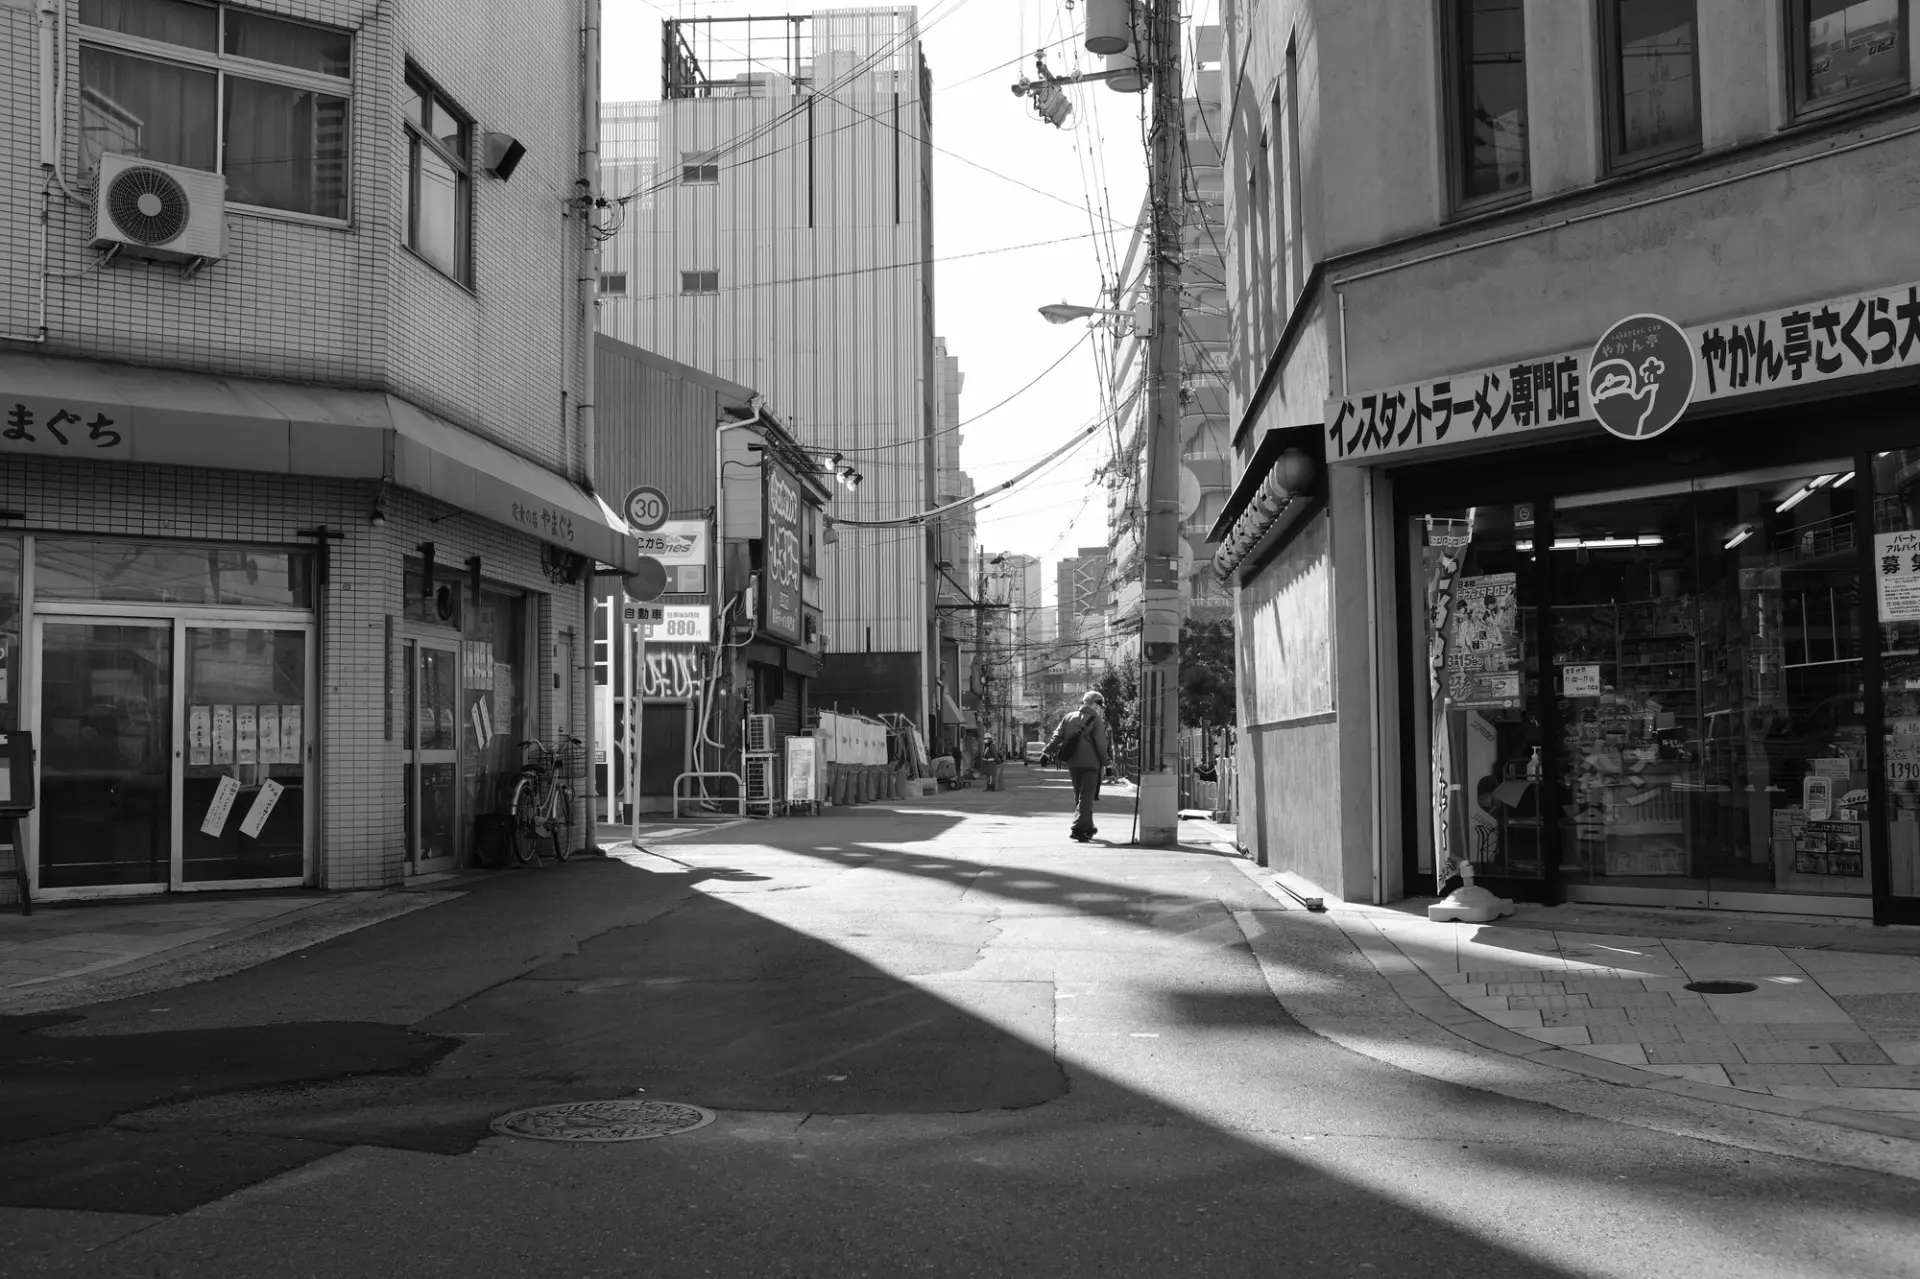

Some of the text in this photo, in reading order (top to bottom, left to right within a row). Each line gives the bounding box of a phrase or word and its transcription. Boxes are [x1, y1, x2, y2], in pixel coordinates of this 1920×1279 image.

[1602, 333, 1659, 358] やかん亭
[1701, 286, 1920, 394] やかん亭さくら大
[1329, 355, 1581, 457] インスタントラーメン専門店
[2, 403, 122, 448] まぐち
[635, 499, 660, 519] 30
[541, 507, 574, 542] やまぐち
[638, 537, 665, 550] こから
[624, 608, 663, 620] 自動車
[1890, 762, 1920, 779] 1390
